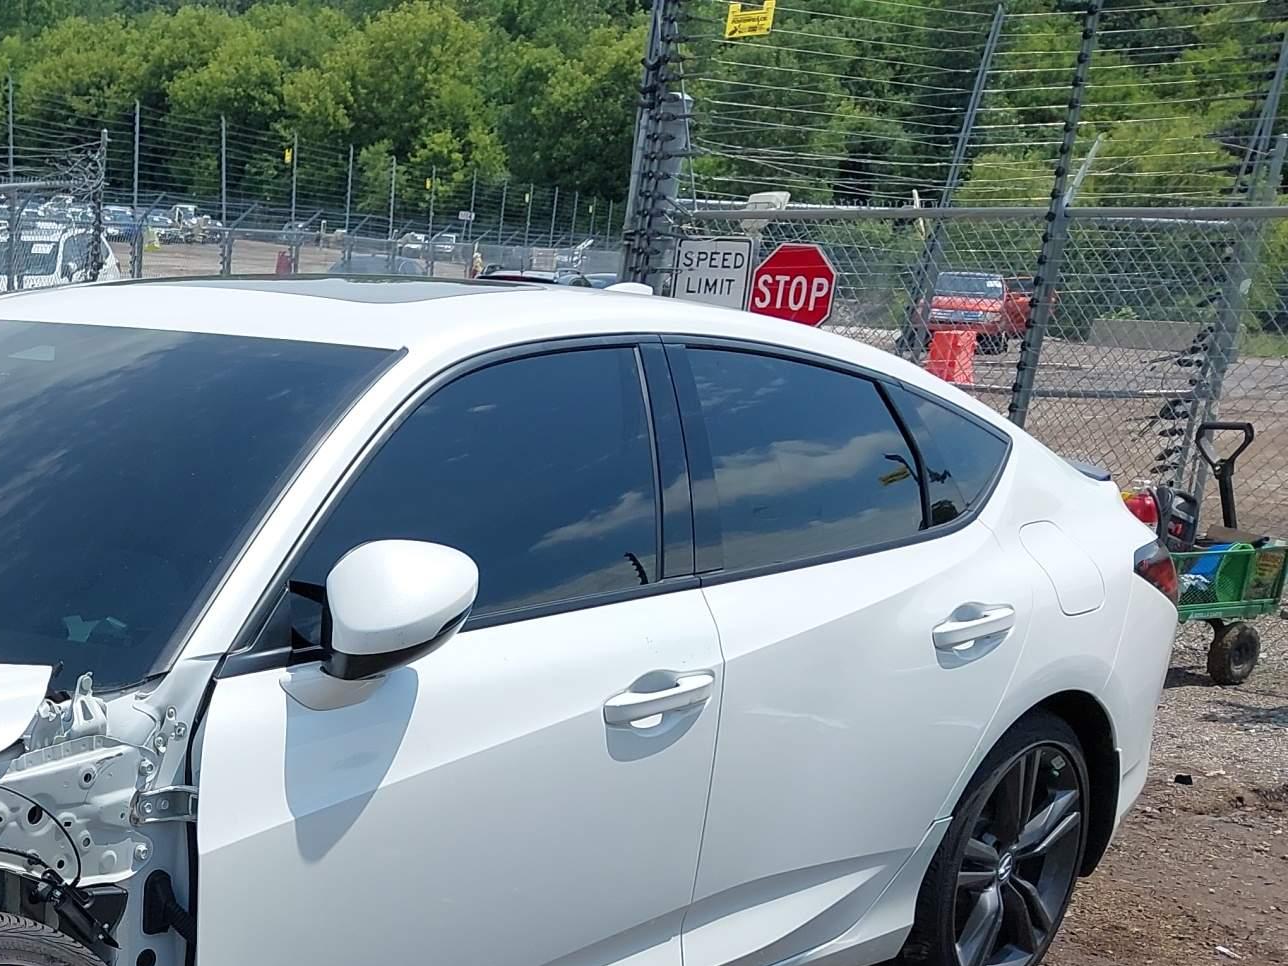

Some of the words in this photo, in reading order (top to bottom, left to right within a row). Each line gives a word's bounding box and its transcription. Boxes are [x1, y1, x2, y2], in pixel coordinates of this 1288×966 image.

[682, 250, 746, 270] SPEED
[685, 277, 736, 296] LIMIT
[754, 273, 830, 312] STOP
